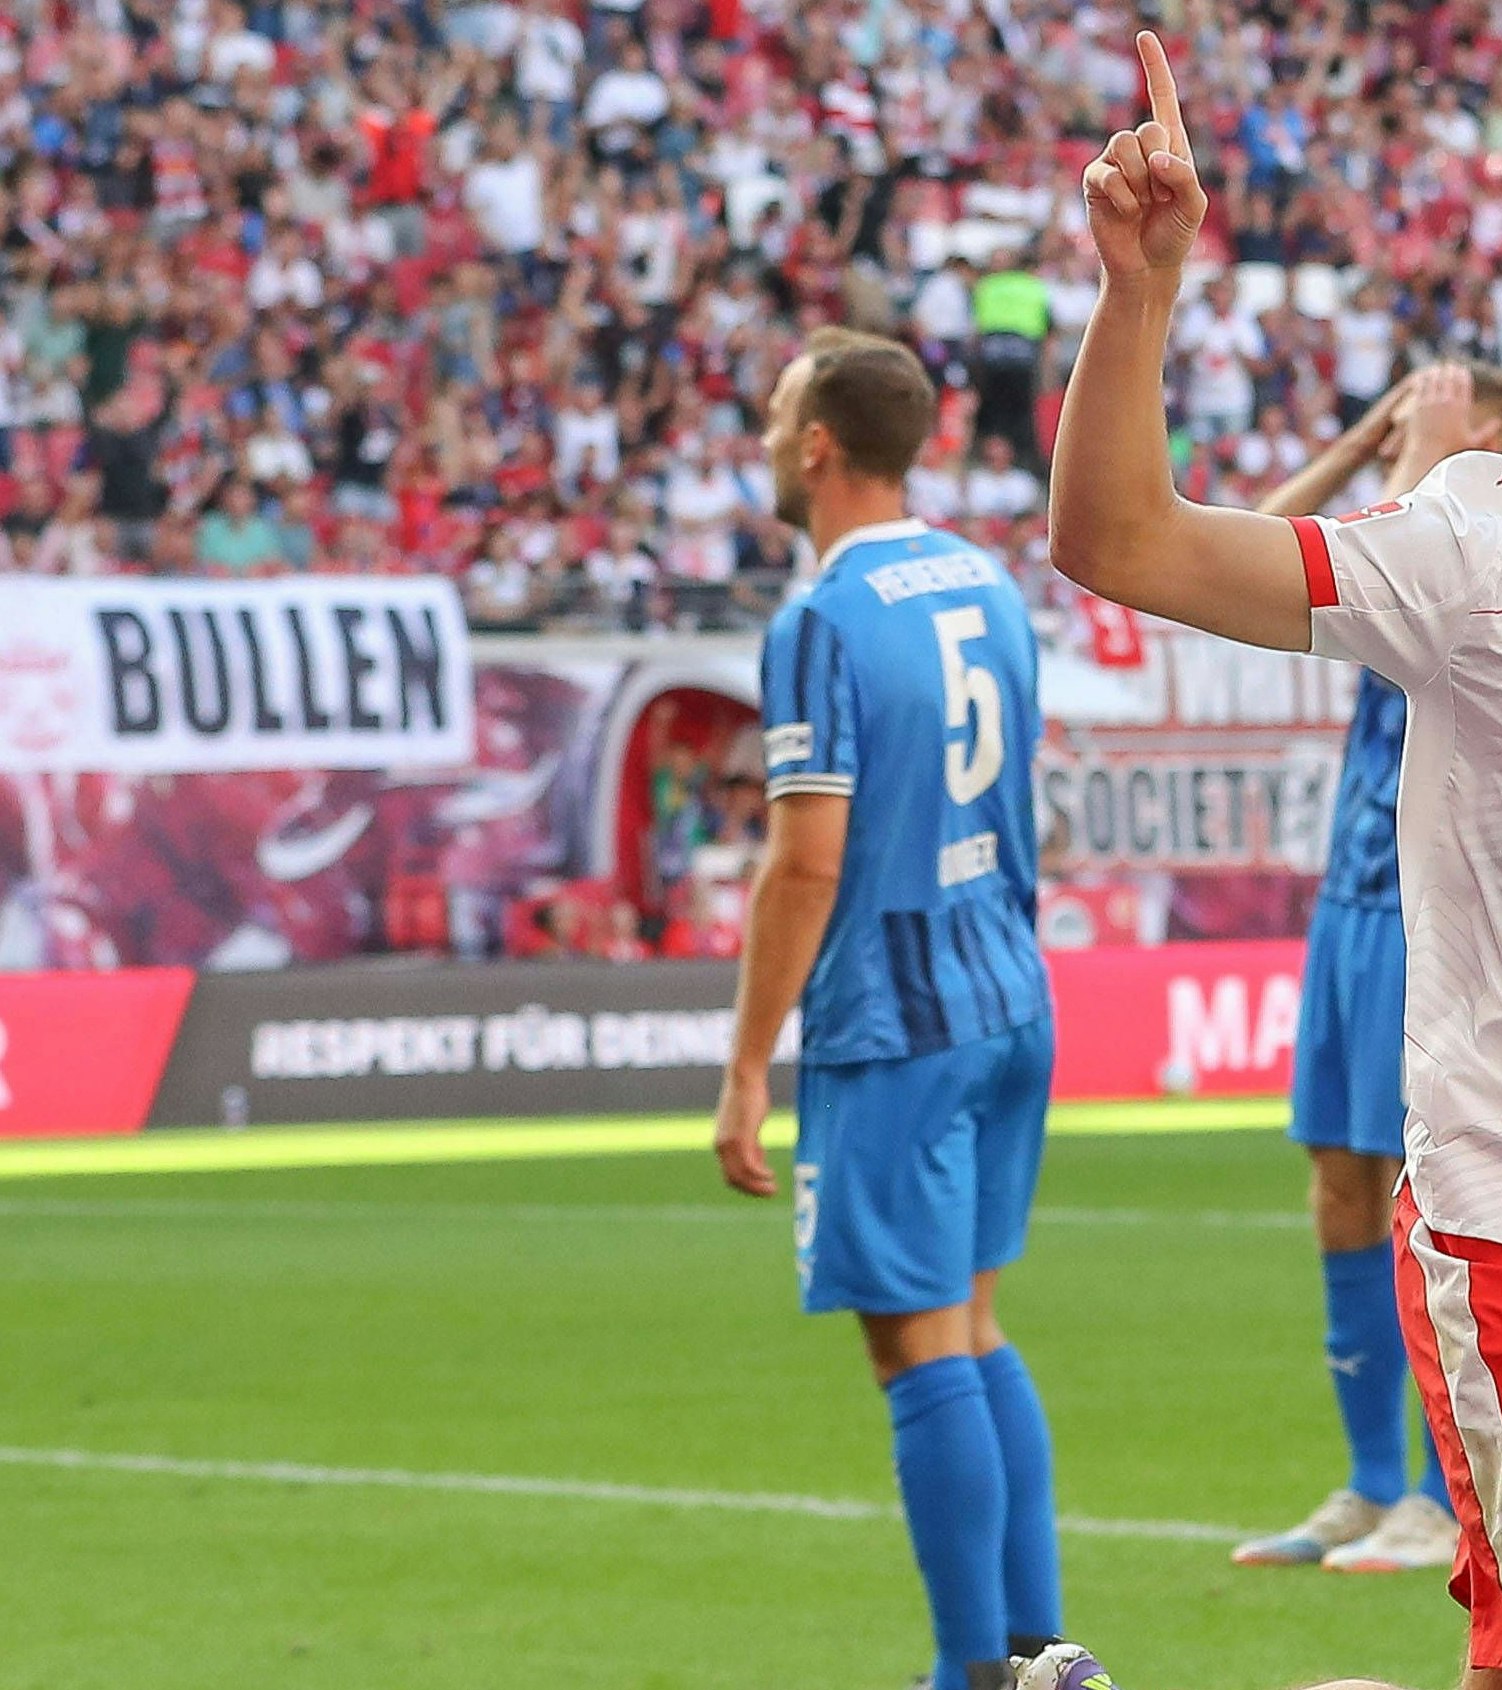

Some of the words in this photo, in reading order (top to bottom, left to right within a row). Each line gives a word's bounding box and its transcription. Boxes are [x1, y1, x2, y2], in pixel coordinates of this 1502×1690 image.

[97, 609, 447, 733] BULLEN
[931, 605, 1004, 806] 5
[252, 1015, 479, 1079] RESPEKT
[483, 1003, 588, 1070] FÜR
